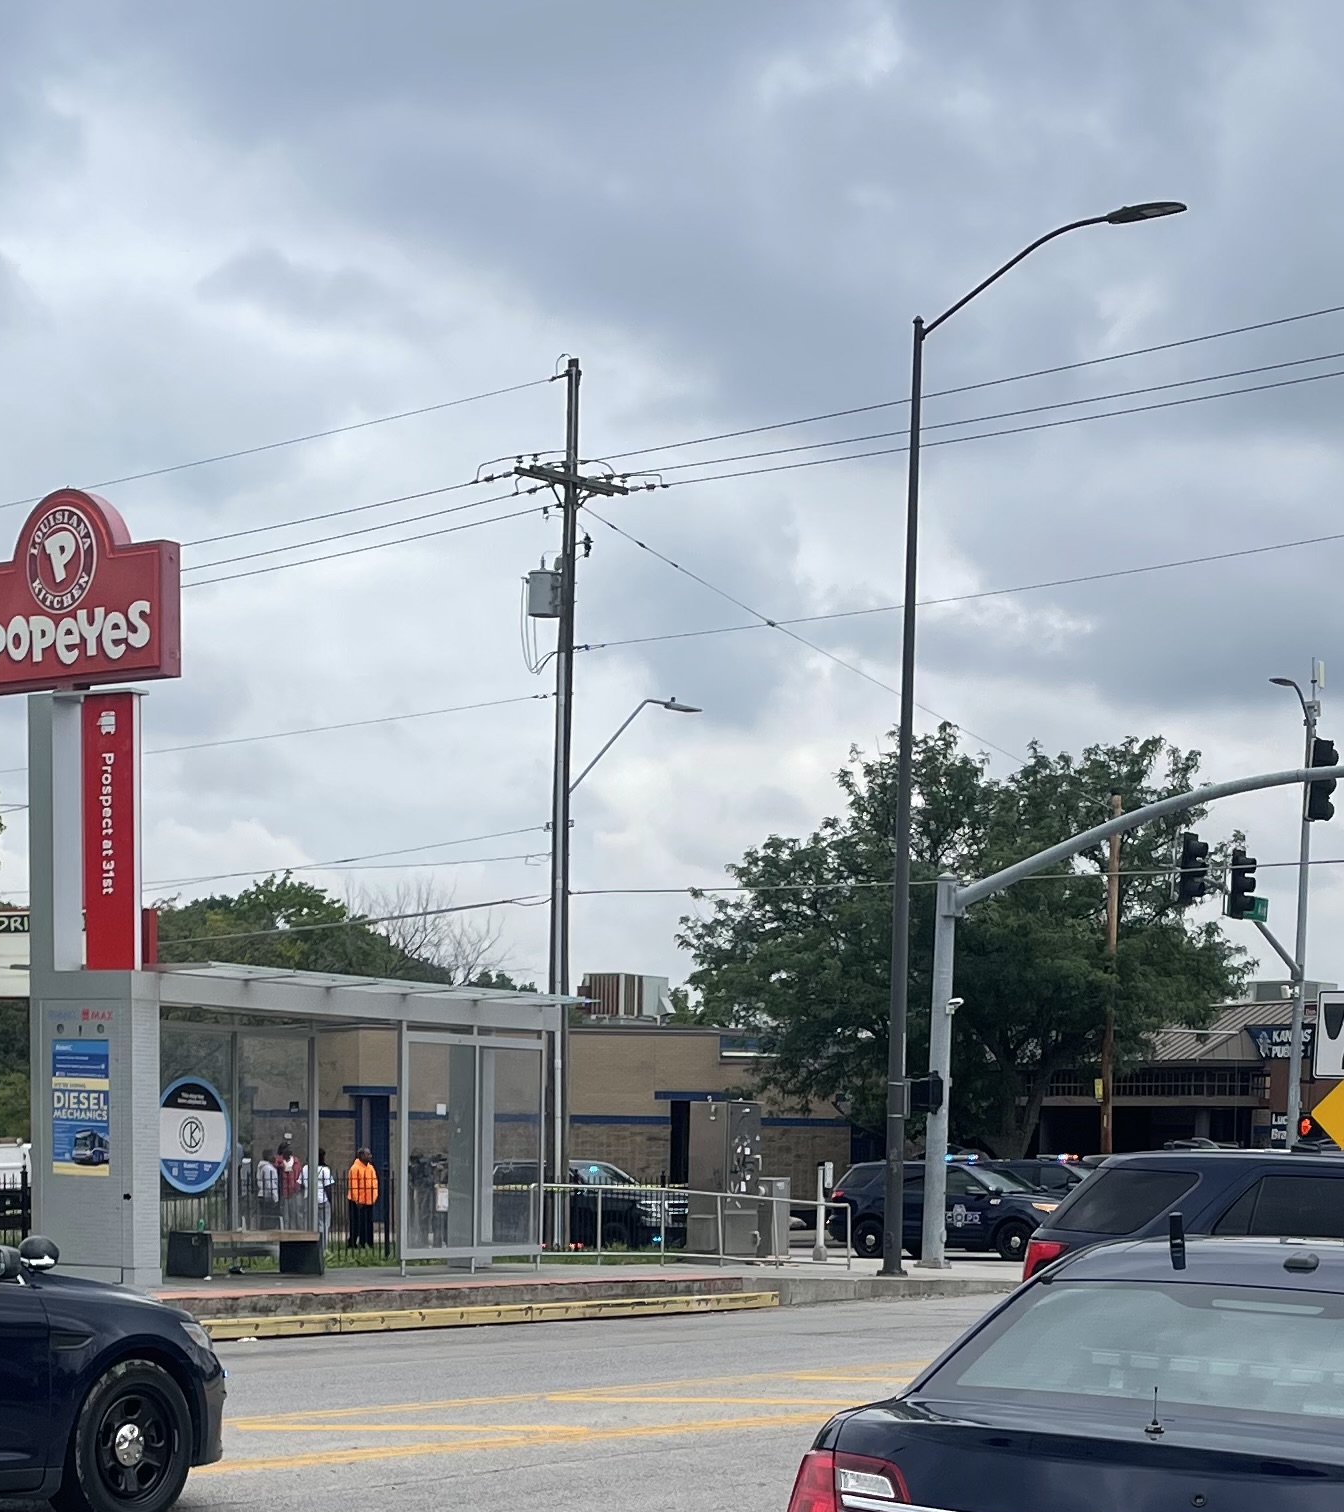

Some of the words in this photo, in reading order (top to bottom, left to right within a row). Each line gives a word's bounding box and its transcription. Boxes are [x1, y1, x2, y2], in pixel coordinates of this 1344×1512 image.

[29, 510, 92, 556] LOUISIANA
[32, 572, 89, 608] KITCHEN
[101, 752, 115, 836] Prospect
[101, 840, 114, 857] at
[101, 860, 115, 895] 31st
[53, 1091, 108, 1110] DIESEL
[53, 1109, 108, 1121] MECHANICS
[1271, 1113, 1289, 1125] Luc
[1271, 1128, 1287, 1140] Bra
